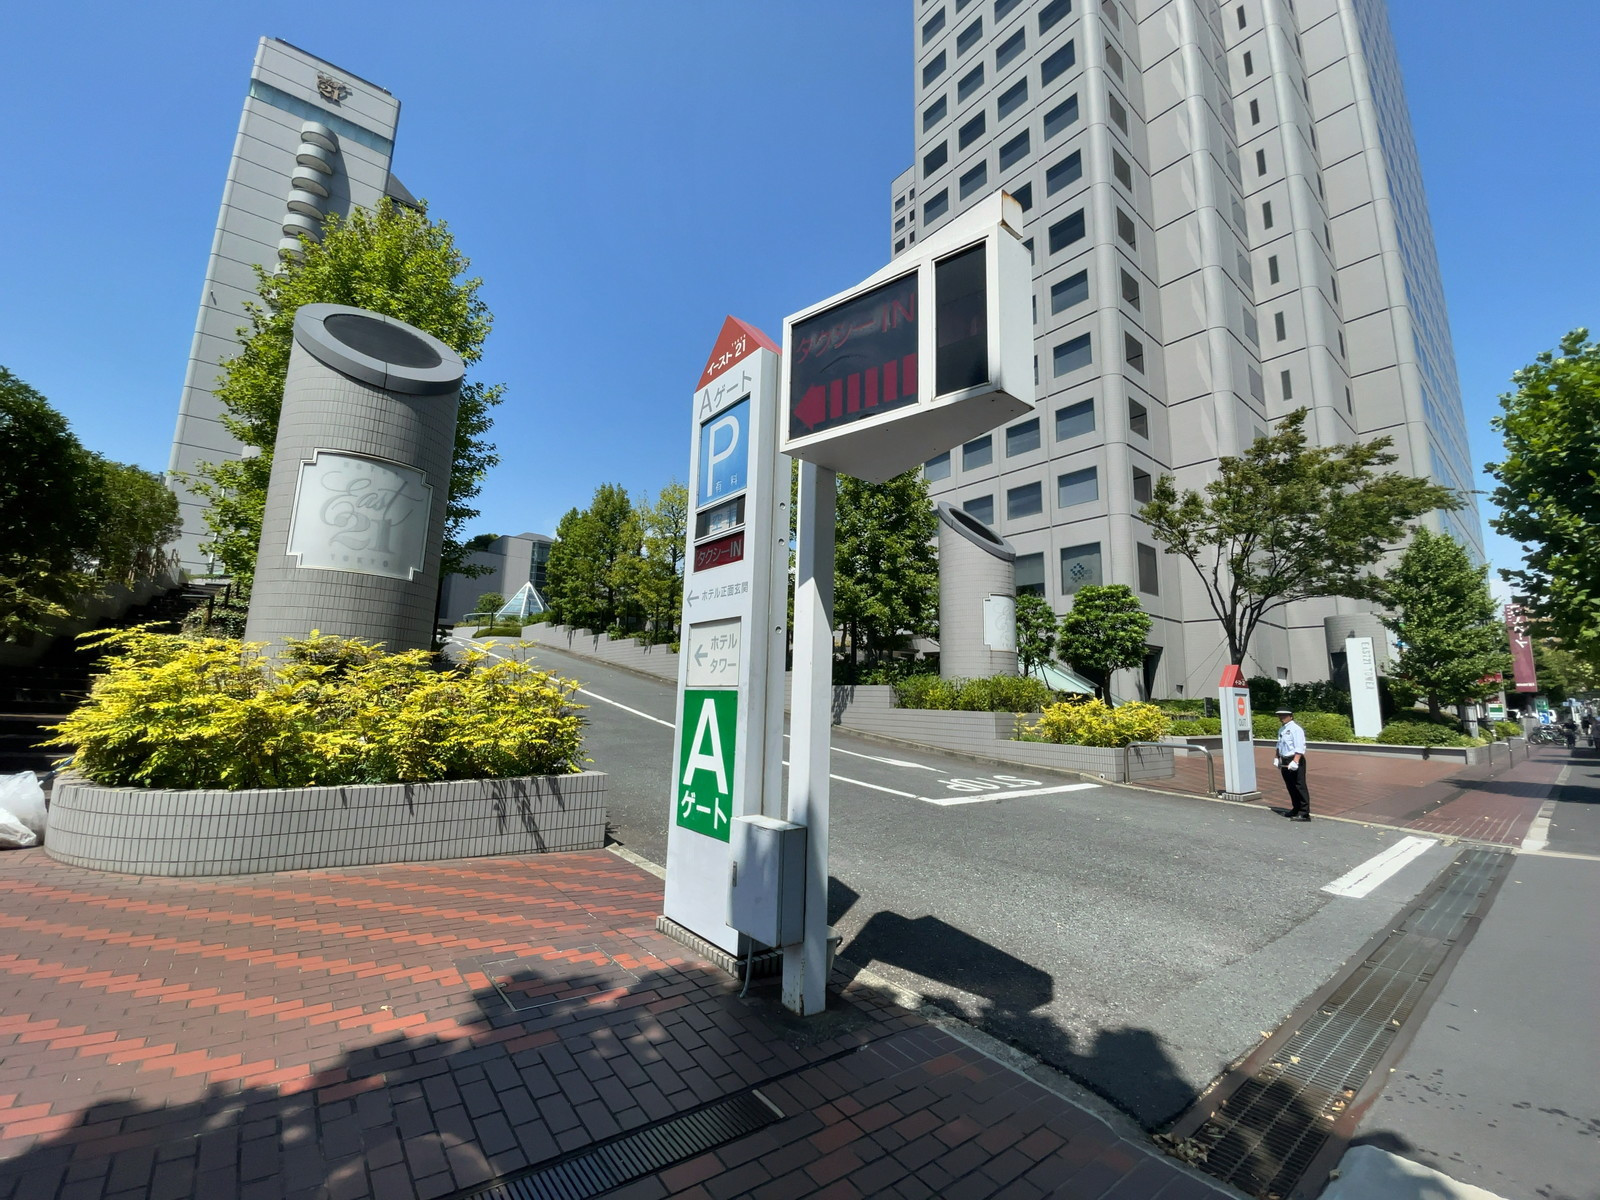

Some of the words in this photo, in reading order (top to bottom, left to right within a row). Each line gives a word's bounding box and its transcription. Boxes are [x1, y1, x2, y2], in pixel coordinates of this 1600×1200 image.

[797, 293, 915, 363] タクシーIN
[699, 370, 752, 419] Aゲート
[707, 415, 740, 497] P
[320, 471, 423, 526] East
[329, 508, 393, 553] 21
[697, 539, 742, 566] タクシーIN
[701, 581, 749, 601] ホテル正面玄関
[710, 633, 738, 650] ホテル
[709, 658, 737, 673] タワー
[682, 698, 729, 795] A
[681, 790, 727, 829] ゲート
